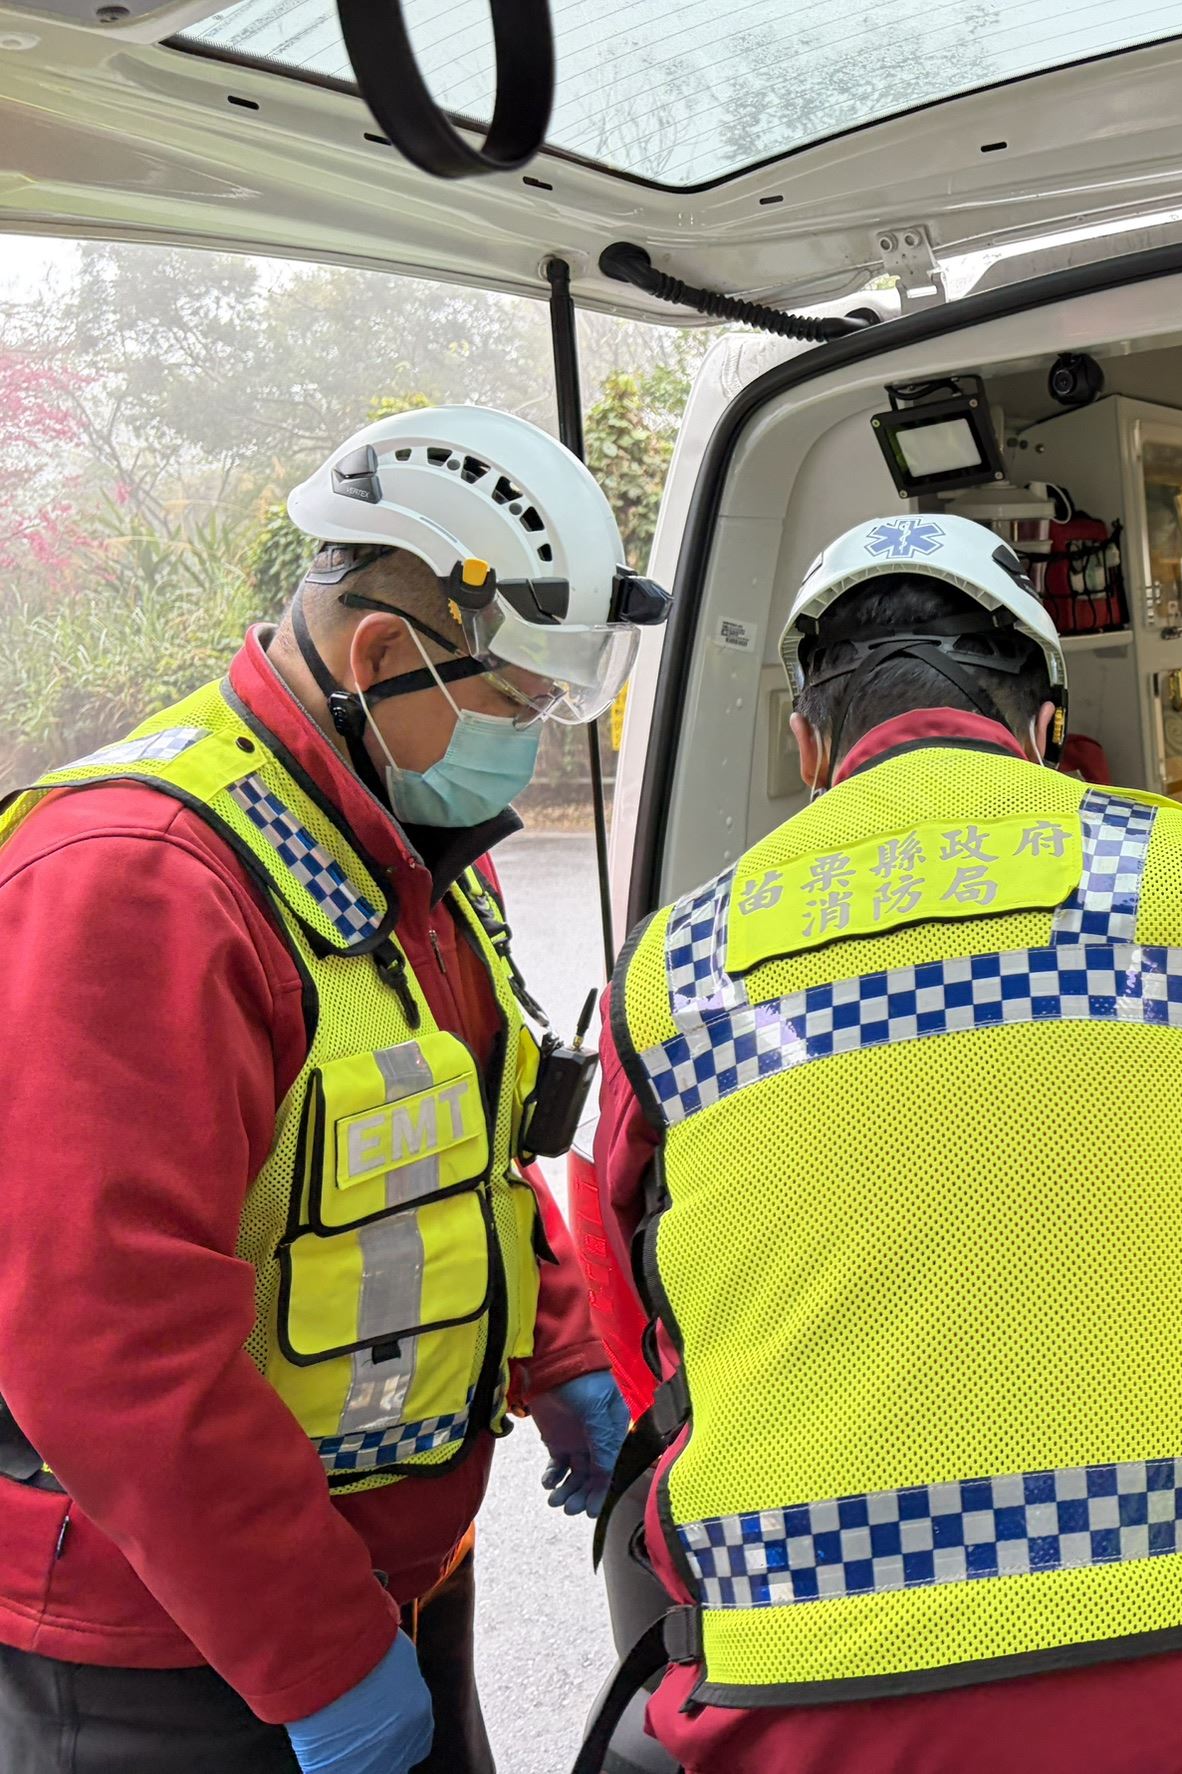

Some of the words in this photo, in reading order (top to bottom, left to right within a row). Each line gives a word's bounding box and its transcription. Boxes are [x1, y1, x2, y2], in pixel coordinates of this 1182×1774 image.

[735, 820, 1074, 918] 苗栗縣政府
[800, 864, 999, 939] 消防局
[347, 1082, 469, 1178] EMT
